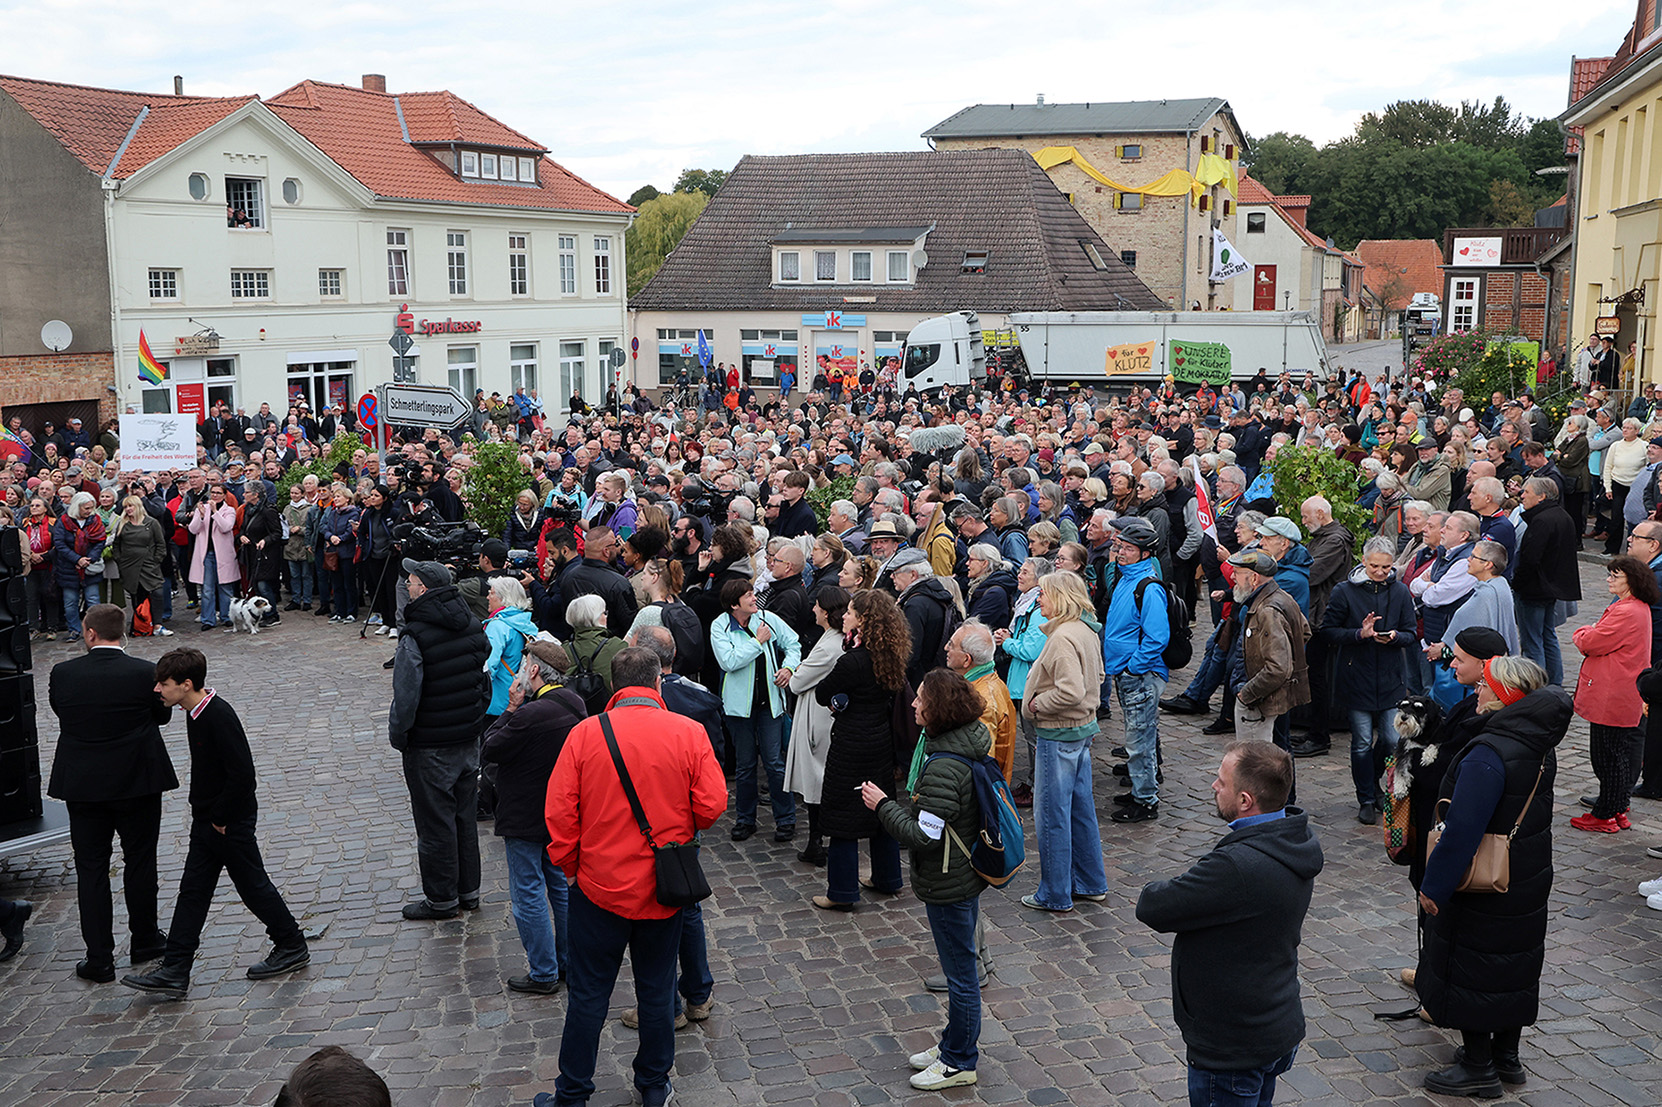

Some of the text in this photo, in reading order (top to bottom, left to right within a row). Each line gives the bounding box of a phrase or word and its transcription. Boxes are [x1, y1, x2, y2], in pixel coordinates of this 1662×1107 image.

[421, 317, 482, 337] Sparkasse
[1184, 346, 1226, 359] UNSERE
[1173, 367, 1230, 380] DEMOKRATEN
[390, 397, 455, 416] Schmetterlingspark
